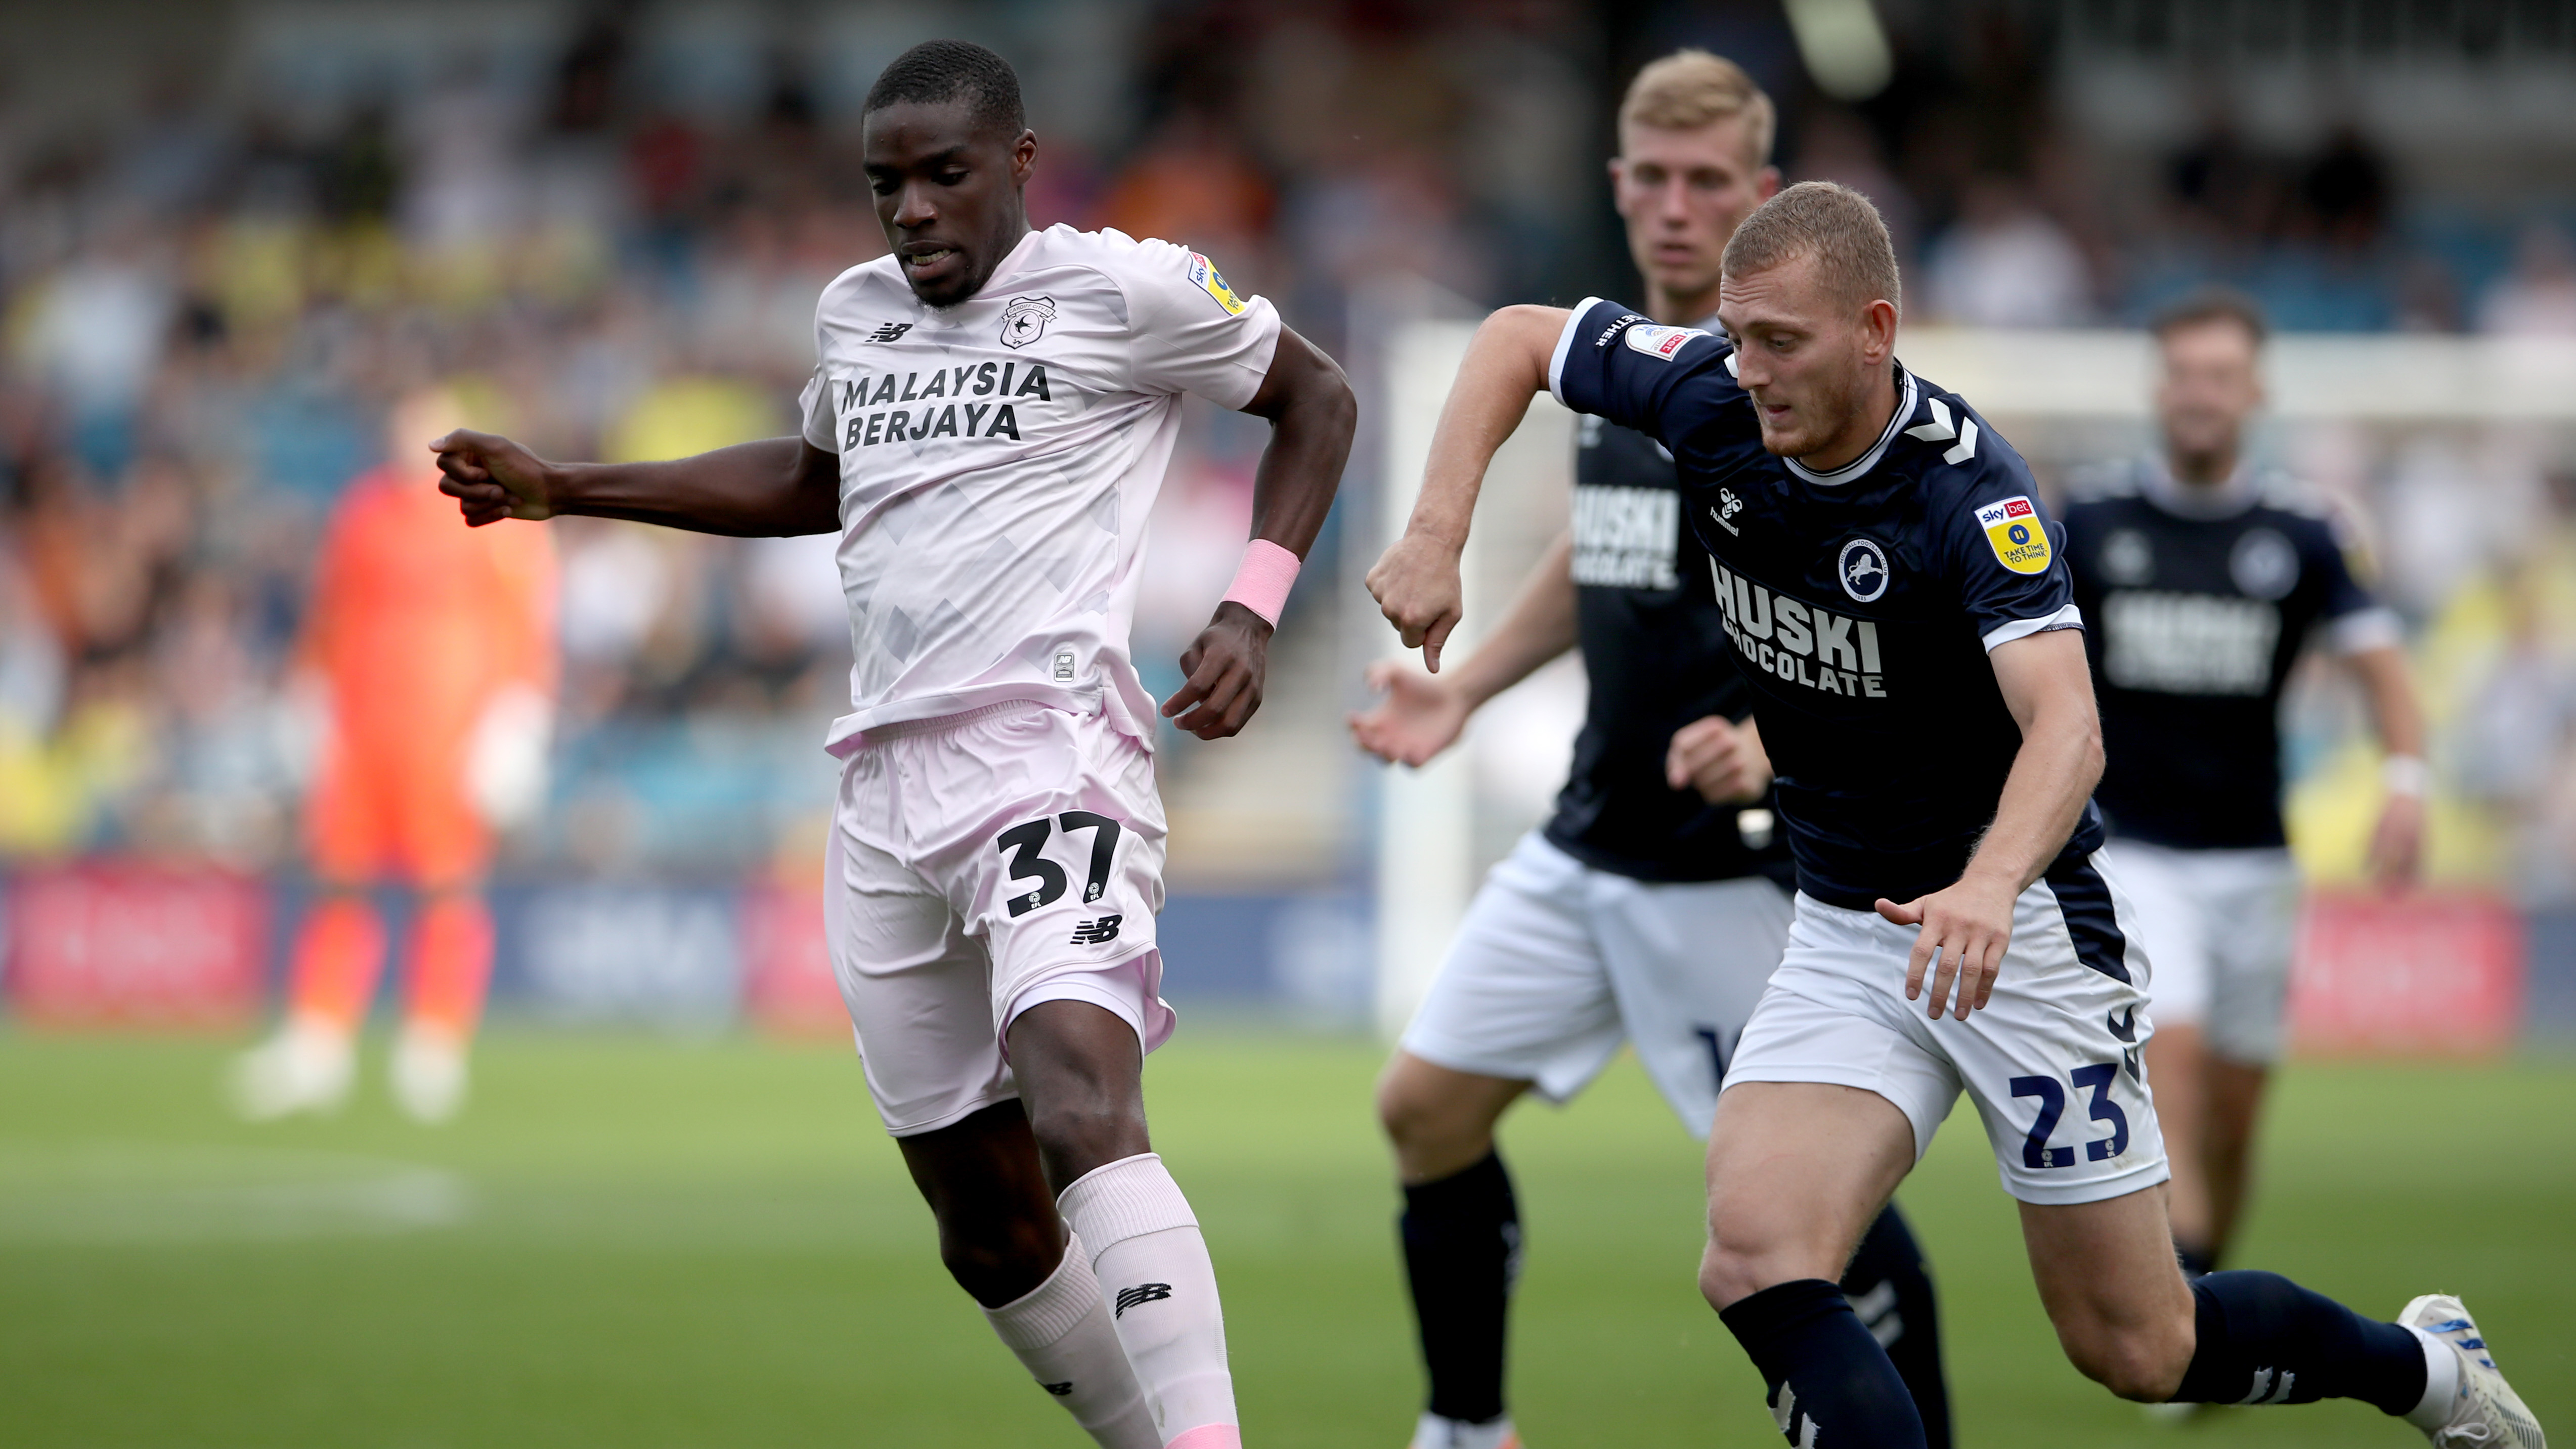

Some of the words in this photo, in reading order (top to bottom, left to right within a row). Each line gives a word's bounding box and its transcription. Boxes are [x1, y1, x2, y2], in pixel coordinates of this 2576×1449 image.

[1196, 264, 1206, 283] sky
[1009, 304, 1032, 314] CARDIFF
[1663, 336, 1684, 351] bet
[841, 362, 1052, 416] MALAYSIA
[844, 404, 1021, 453] BERJAYA
[1710, 506, 1739, 537] hummel
[1982, 508, 2003, 522] sky
[2006, 502, 2029, 514] bet
[1840, 541, 1857, 564] MILLWALL
[1857, 540, 1882, 558] FOOTBALL
[2004, 546, 2026, 558] TAKE
[2027, 543, 2044, 552] TIME
[2010, 555, 2022, 564] TO
[1709, 553, 1882, 673] HUSKI
[997, 811, 1120, 917] 37
[2010, 1063, 2129, 1169] 23
